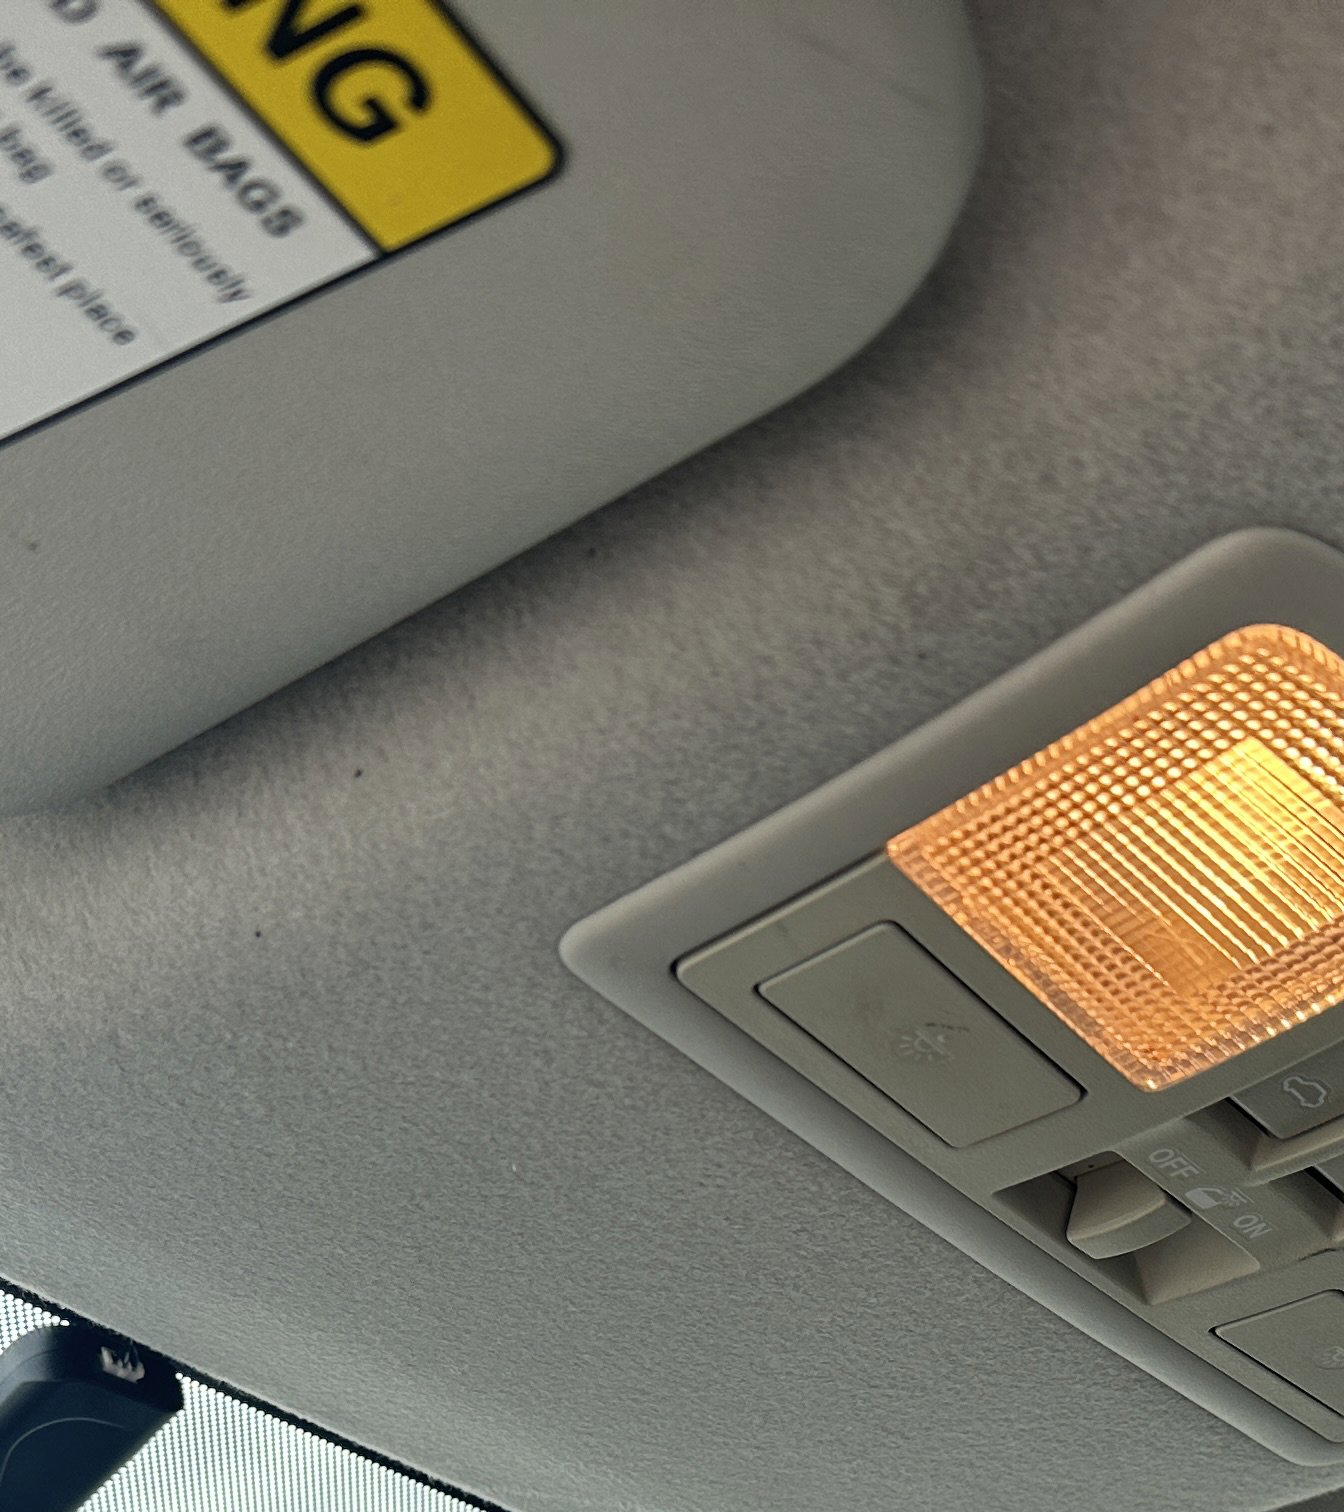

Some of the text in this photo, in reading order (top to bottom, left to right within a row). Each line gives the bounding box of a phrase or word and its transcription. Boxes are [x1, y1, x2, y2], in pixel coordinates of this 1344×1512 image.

[97, 42, 186, 116] AIR
[182, 124, 304, 238] BAGS
[26, 83, 114, 161] killed
[100, 161, 141, 191] or
[132, 193, 251, 303] seriously
[55, 279, 137, 345] place
[1149, 1148, 1202, 1180] OFF
[1233, 1214, 1273, 1239] ON
